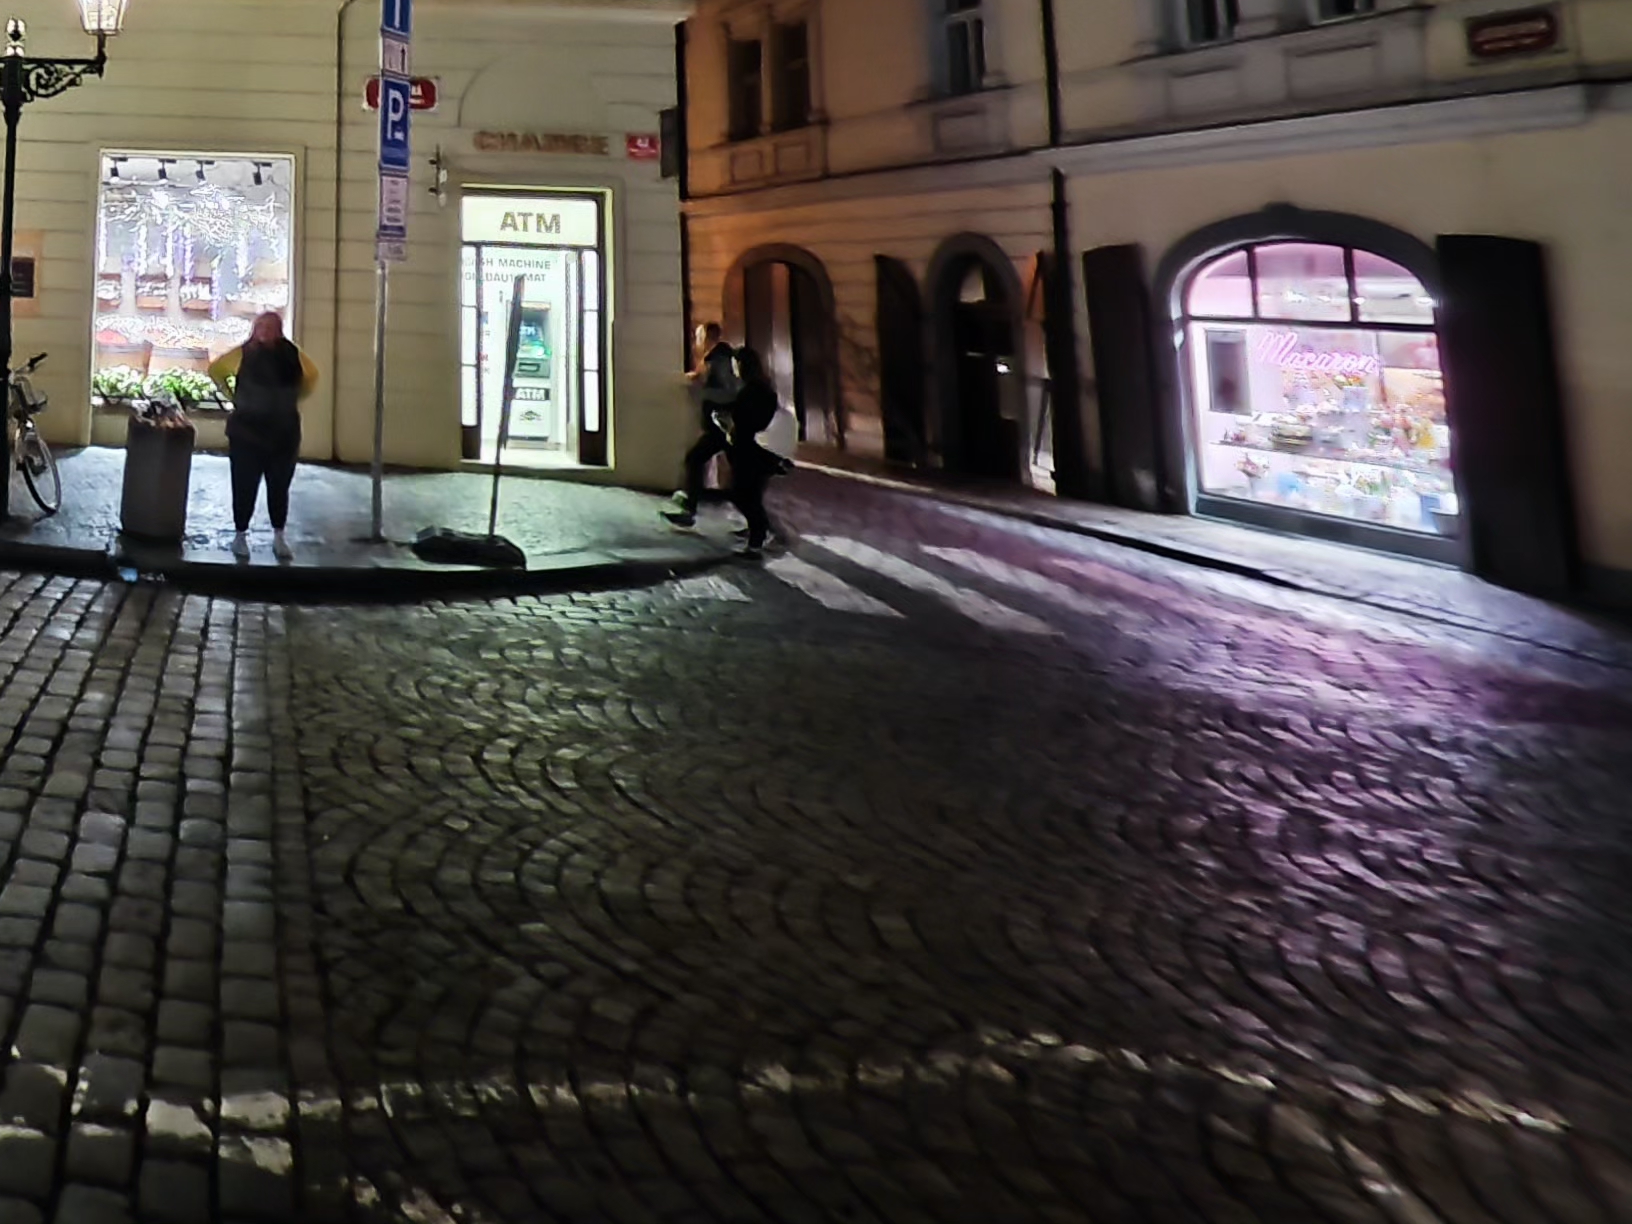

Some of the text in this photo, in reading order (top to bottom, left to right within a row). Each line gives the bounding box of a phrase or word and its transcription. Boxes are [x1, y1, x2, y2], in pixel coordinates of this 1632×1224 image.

[386, 88, 404, 140] P
[500, 211, 561, 234] ATM
[498, 258, 551, 270] MACHINE
[515, 388, 546, 401] ATM
